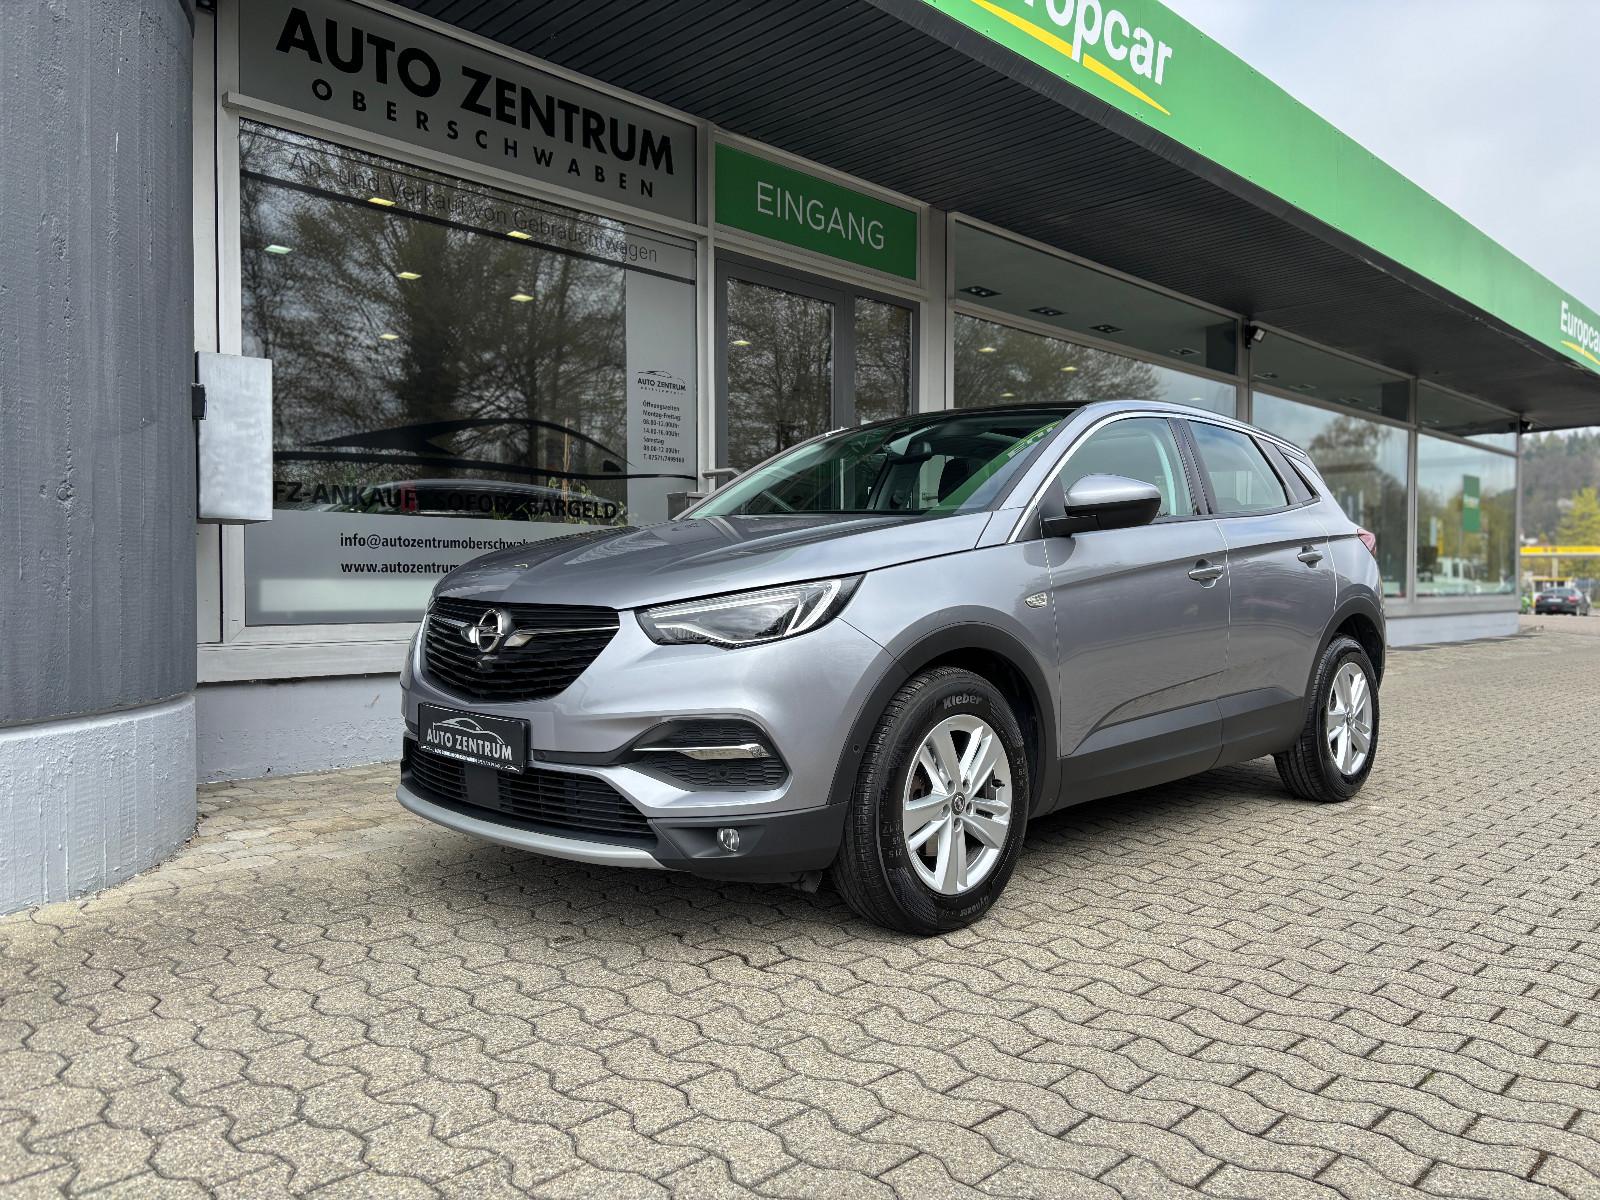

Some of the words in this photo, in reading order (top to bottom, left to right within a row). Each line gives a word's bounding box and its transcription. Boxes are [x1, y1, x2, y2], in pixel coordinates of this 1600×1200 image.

[1024, 0, 1172, 85] opcar
[276, 9, 441, 98] AUTO
[460, 66, 675, 175] ZENTRUM
[312, 79, 653, 198] OBERSCHWABEN
[339, 170, 381, 193] und
[389, 175, 466, 214] Verkauf
[472, 203, 507, 225] von
[513, 210, 657, 263] Gebrauchtwagen
[756, 181, 885, 250] EINGANG
[1560, 300, 1600, 355] Europca
[637, 377, 656, 387] AUTO
[656, 380, 687, 392] ZENTRUM
[273, 481, 416, 510] FZ-ANKAUF
[528, 494, 617, 519] BARGELD
[943, 693, 983, 709] Kleber
[426, 728, 452, 747] AUTO
[455, 735, 512, 760] ZENTRUM
